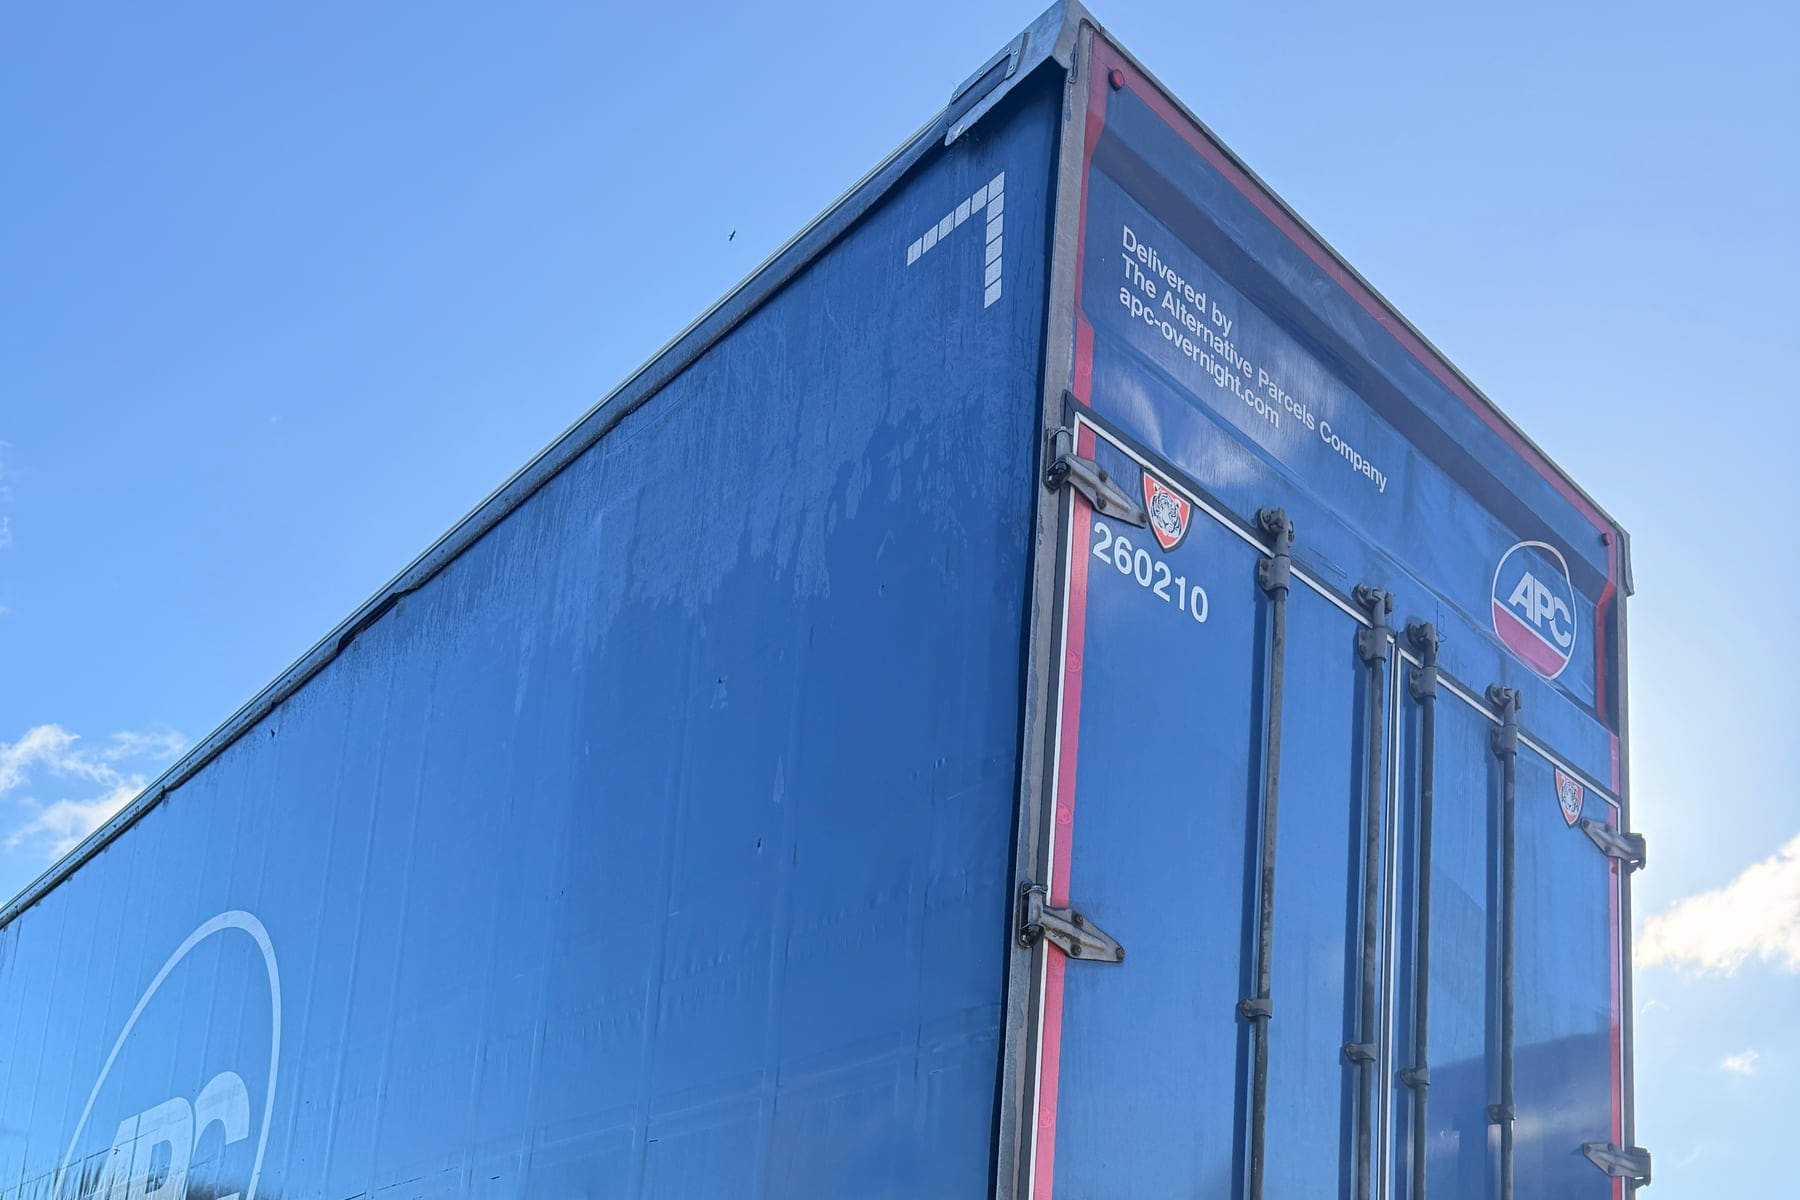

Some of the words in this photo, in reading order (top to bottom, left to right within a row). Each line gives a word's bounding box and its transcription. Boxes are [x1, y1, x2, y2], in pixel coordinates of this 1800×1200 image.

[1123, 225, 1206, 314] Delivered
[1211, 301, 1232, 337] by
[1120, 287, 1279, 428] apc-overnight.com
[1122, 253, 1156, 298] The
[1162, 290, 1252, 377] Alternative
[1258, 367, 1315, 430] Parcels
[1320, 420, 1387, 493] Company
[1092, 522, 1209, 623] 260210
[1508, 571, 1572, 648] APC
